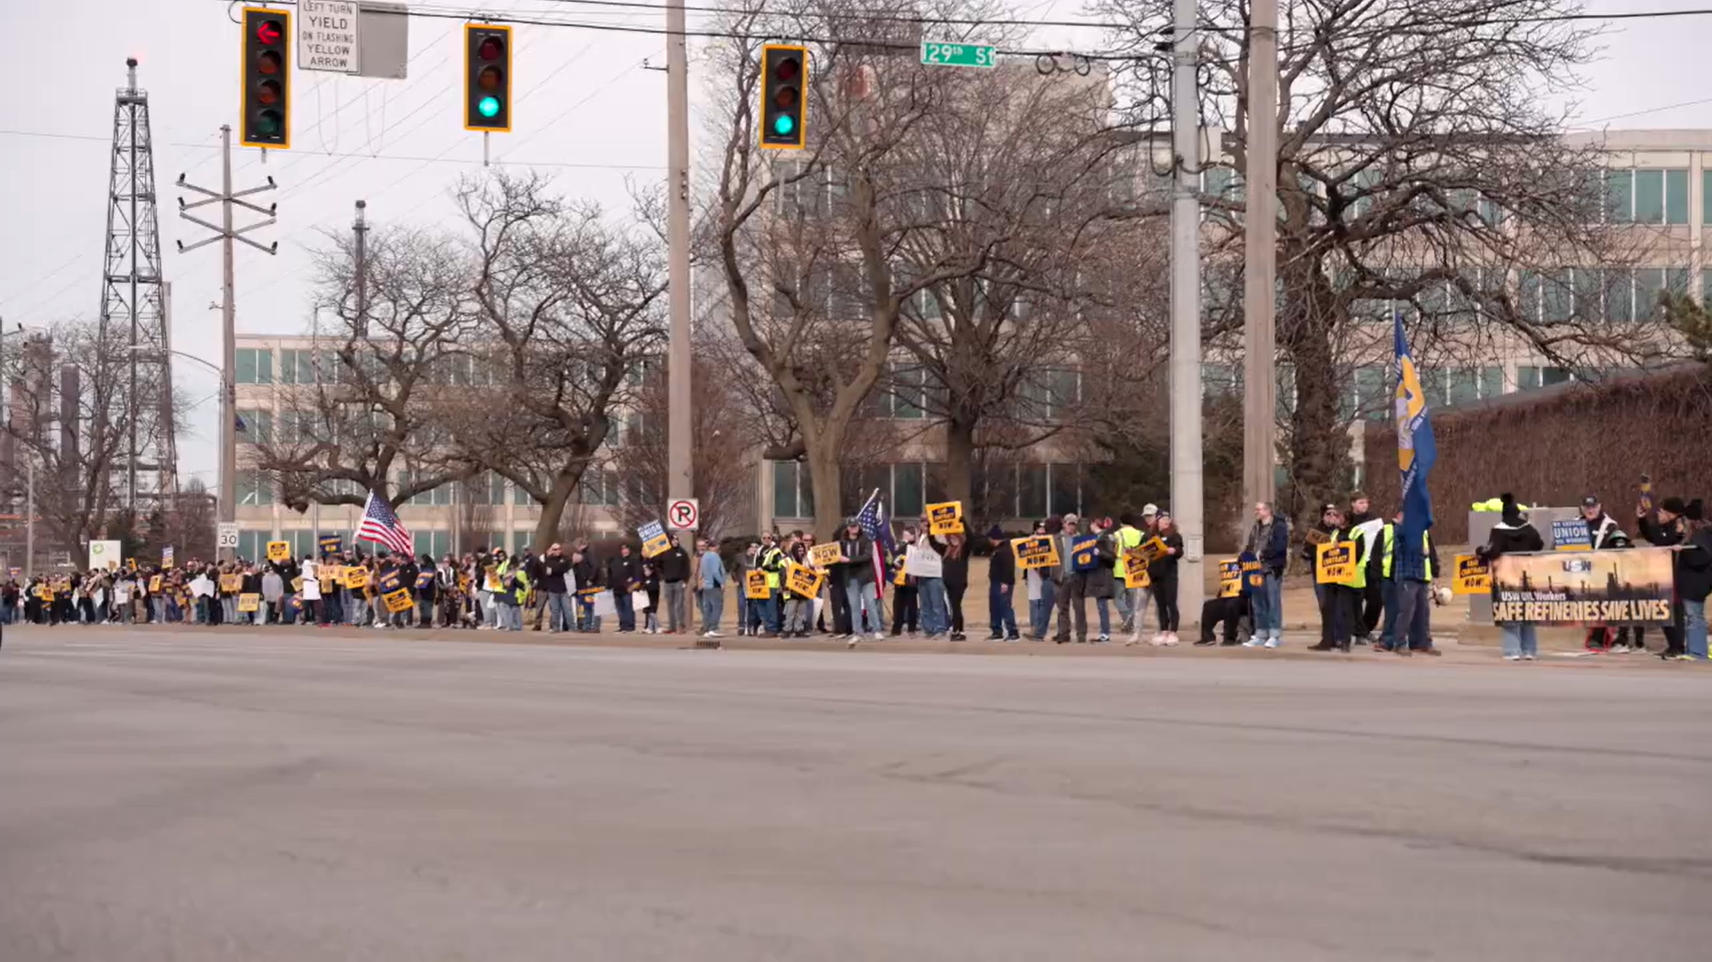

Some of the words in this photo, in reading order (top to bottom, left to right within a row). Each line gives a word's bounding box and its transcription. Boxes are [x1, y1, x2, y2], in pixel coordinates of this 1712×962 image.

[303, 2, 324, 12] LEFT
[329, 4, 352, 14] TURN
[309, 16, 348, 29] YIELD
[302, 31, 313, 40] ON
[317, 32, 354, 43] FLASHING
[307, 44, 350, 55] YELLOW
[310, 57, 347, 67] ARROW
[975, 47, 995, 65] St
[1553, 526, 1588, 538] UNION
[220, 535, 237, 545] 30
[1562, 561, 1592, 572] USW
[1501, 591, 1520, 601] USW
[1535, 590, 1567, 601] Workers
[1492, 601, 1524, 621] SAFE
[1525, 600, 1600, 620] REFINERIES
[1600, 600, 1629, 620] SAVE
[1629, 599, 1670, 620] LIVES
